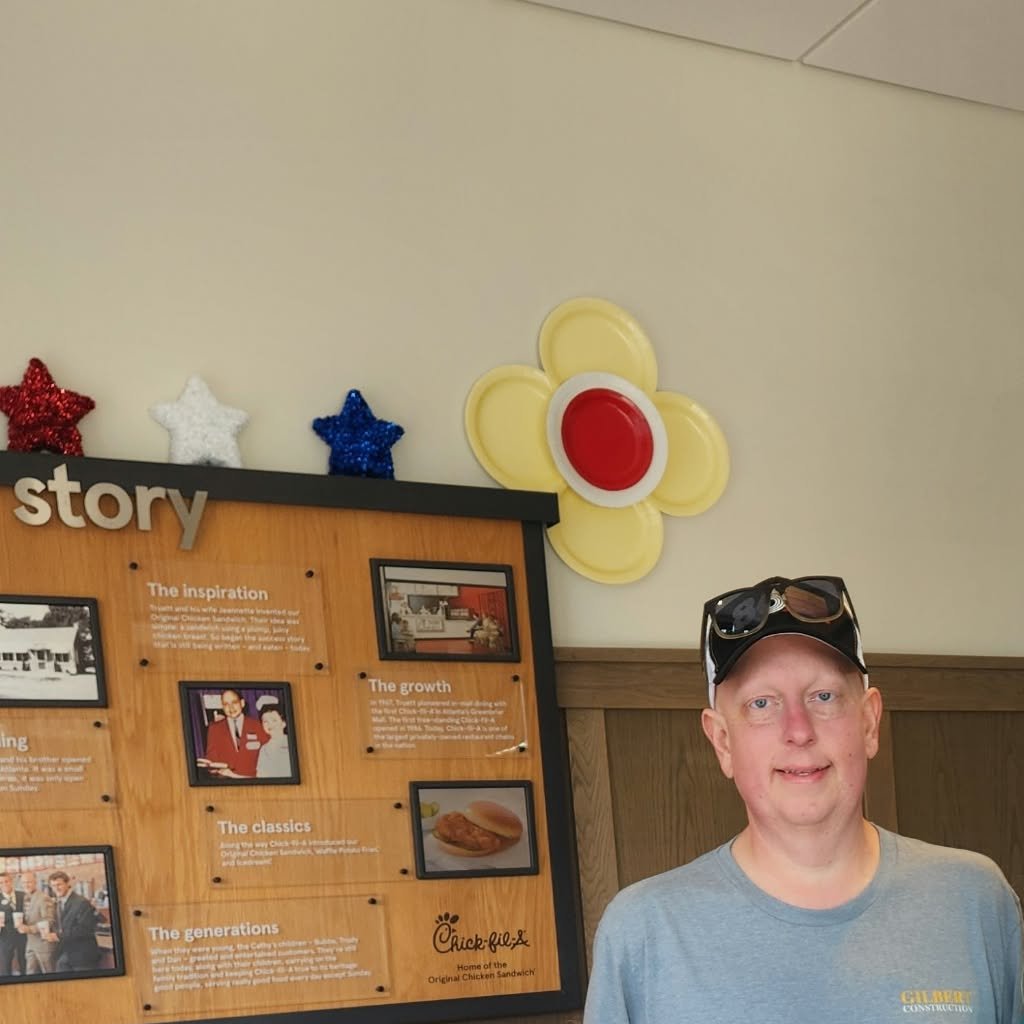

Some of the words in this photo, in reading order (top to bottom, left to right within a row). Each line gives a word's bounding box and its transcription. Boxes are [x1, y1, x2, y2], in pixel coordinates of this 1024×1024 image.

[14, 463, 208, 550] story
[147, 582, 179, 597] The
[182, 584, 269, 602] inspiration
[368, 678, 396, 692] The
[400, 680, 452, 695] growth
[0, 731, 28, 751] ing
[217, 820, 248, 834] The
[252, 819, 312, 833] classics
[149, 927, 180, 941] The
[184, 922, 280, 942] generations
[457, 962, 481, 971] Home
[483, 961, 492, 969] of
[494, 961, 507, 969] the
[428, 975, 460, 985] Original
[462, 972, 495, 981] Chicken
